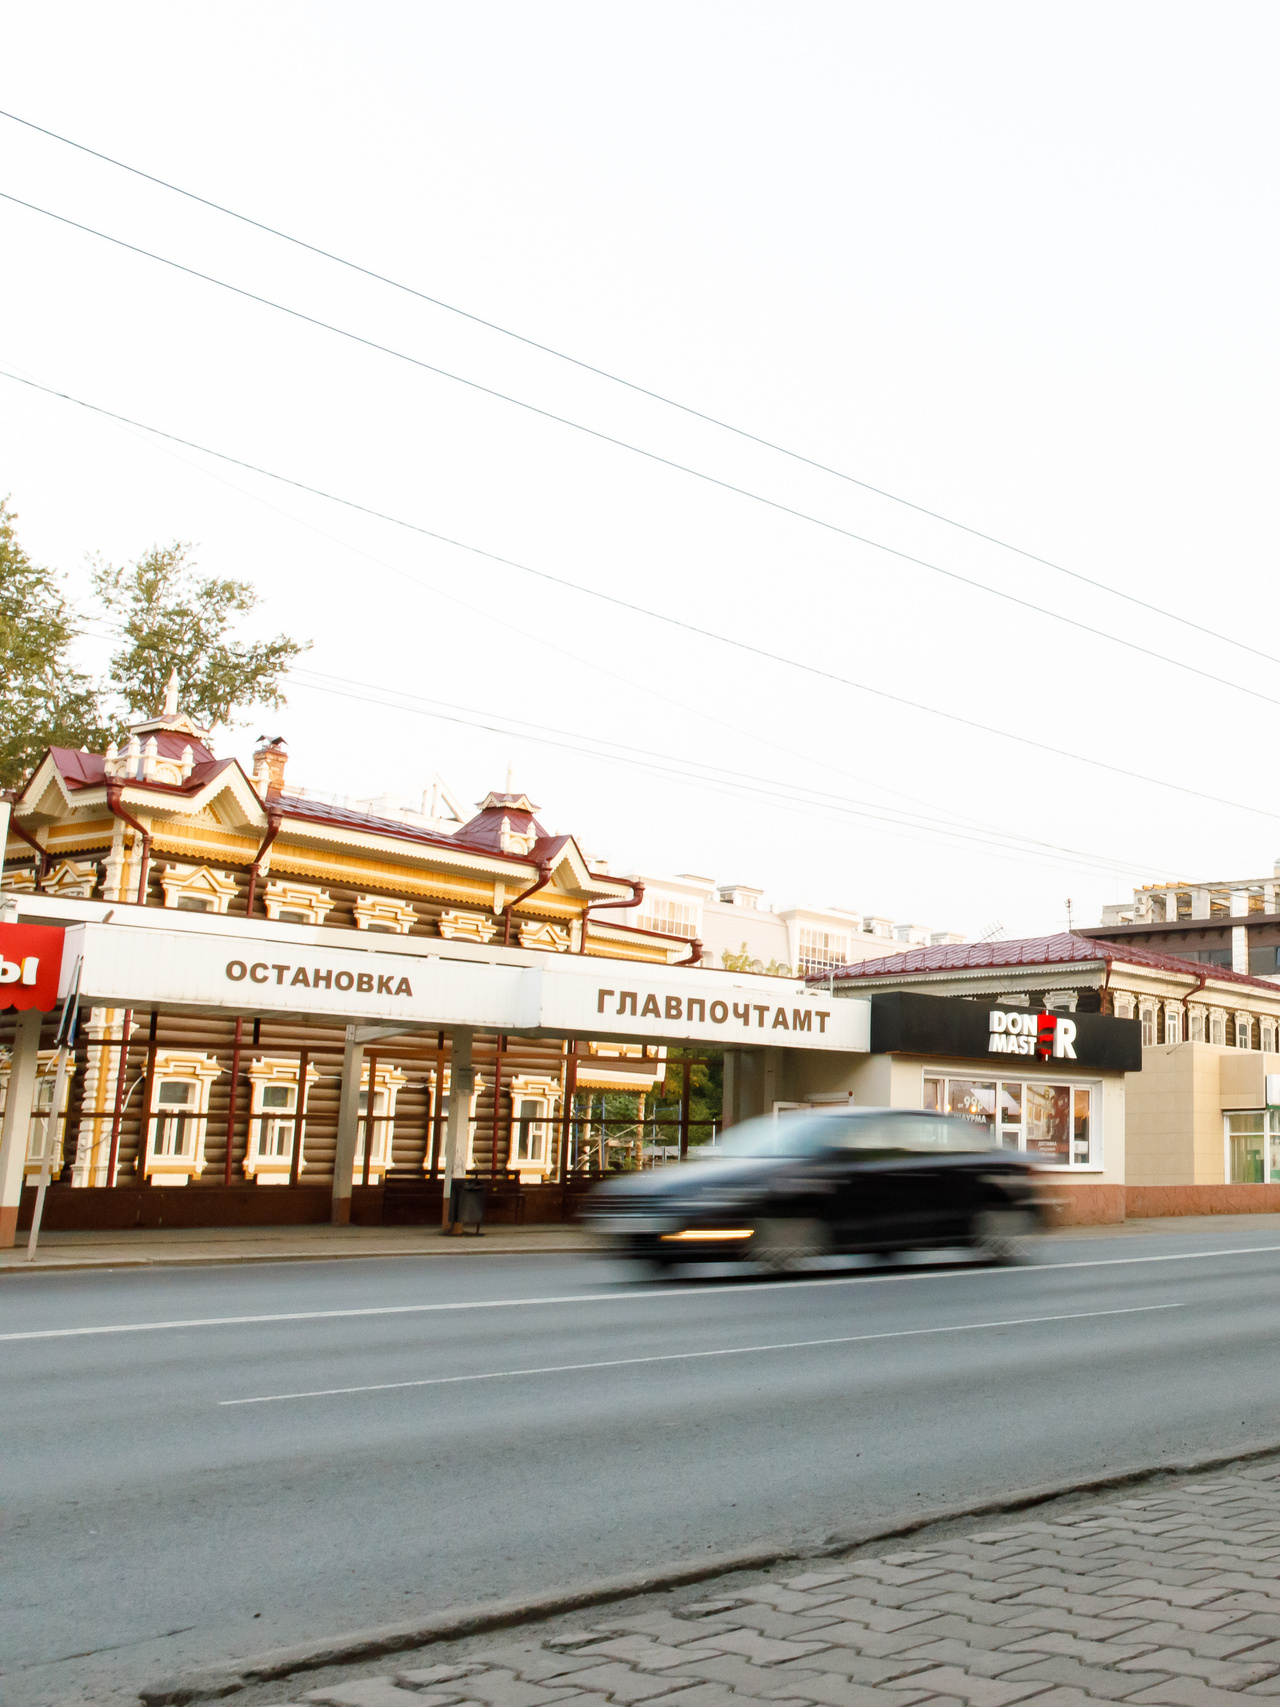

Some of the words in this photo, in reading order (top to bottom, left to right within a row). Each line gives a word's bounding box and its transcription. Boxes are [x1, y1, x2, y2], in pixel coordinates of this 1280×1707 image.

[0, 954, 40, 986] Ы
[225, 960, 413, 997] ОСТАНОВКА
[597, 988, 831, 1033] ГЛАВПОЧТАМТ
